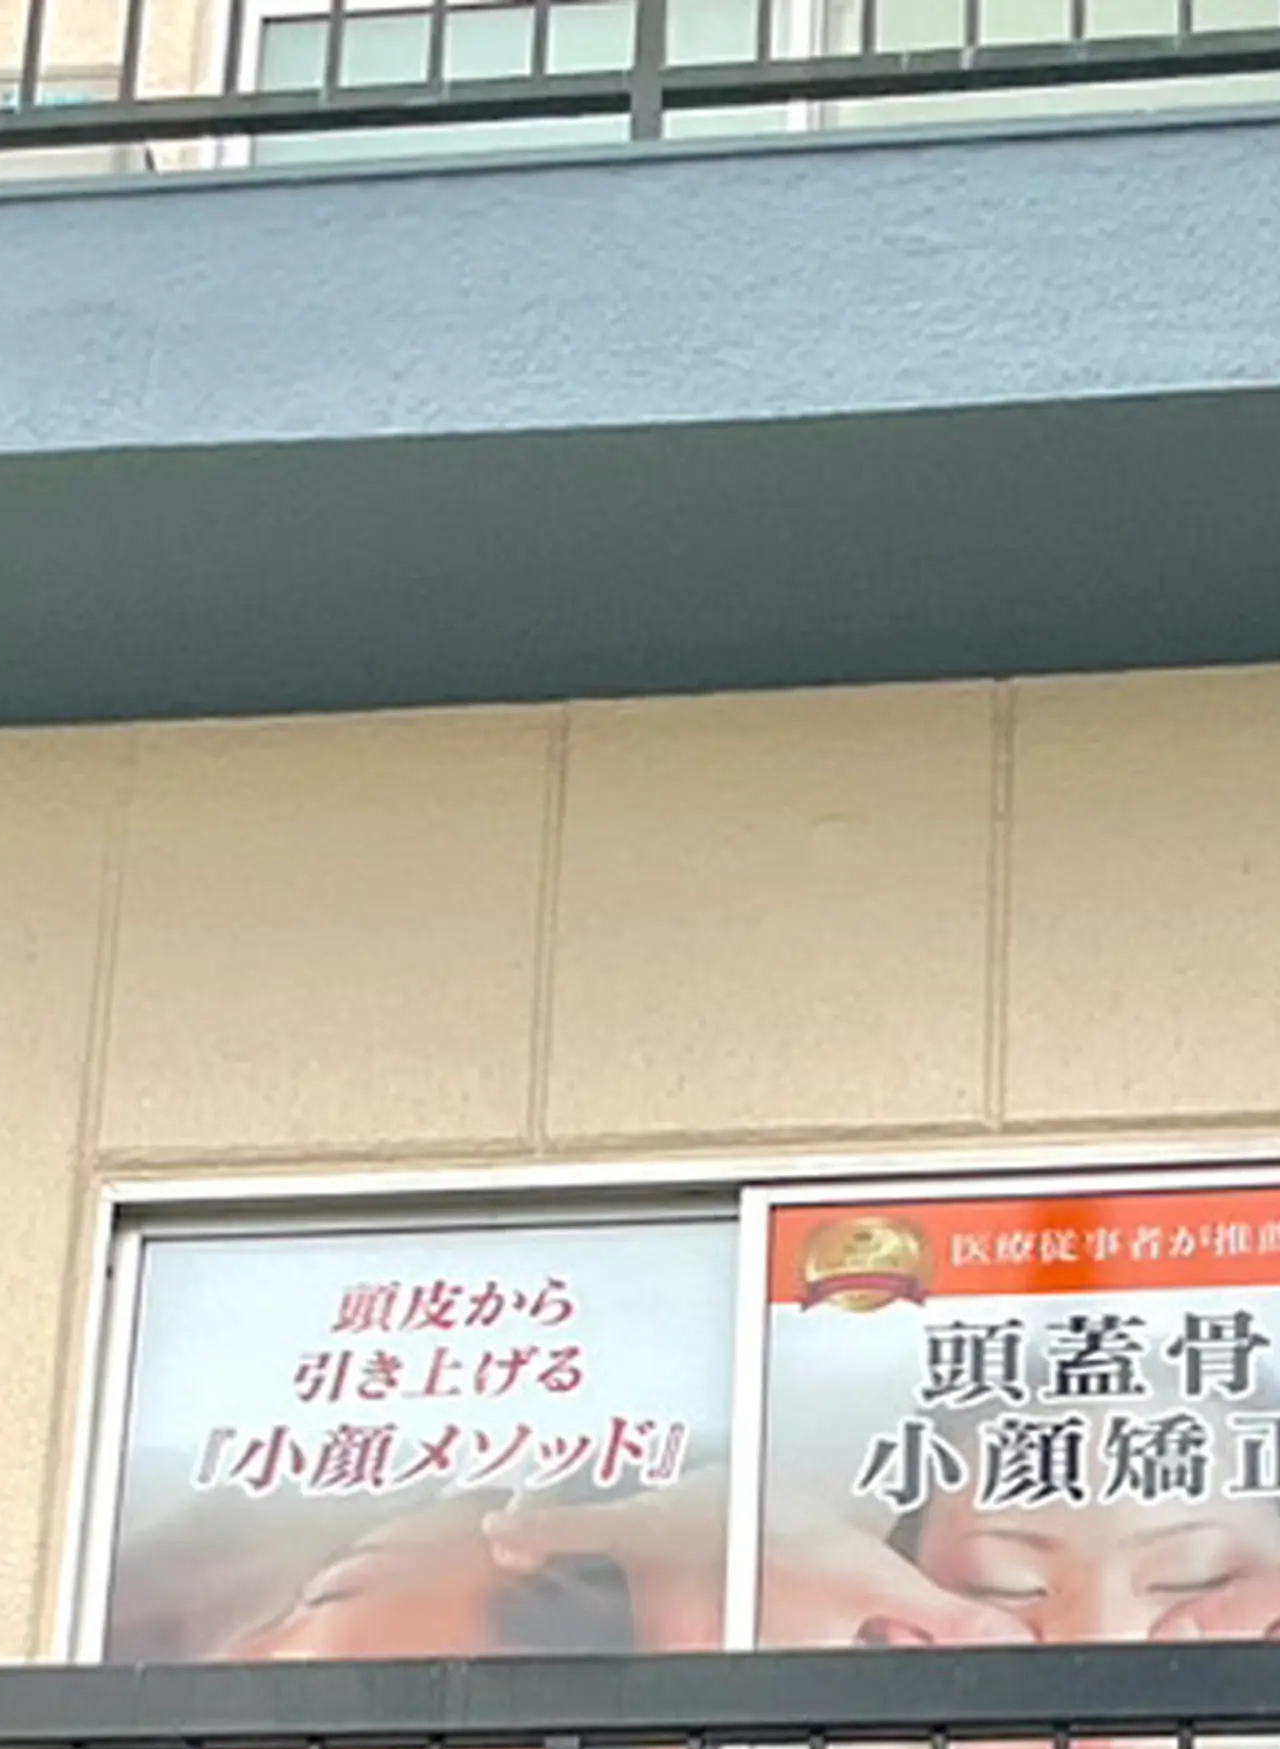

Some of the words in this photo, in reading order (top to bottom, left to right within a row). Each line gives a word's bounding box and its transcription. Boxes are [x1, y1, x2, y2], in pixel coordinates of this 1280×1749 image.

[331, 1278, 575, 1333] 頭皮から
[294, 1345, 585, 1403] 引き上げる
[920, 1308, 1273, 1403] 頭蓋骨
[197, 1416, 688, 1492] 『小顔メソッド』
